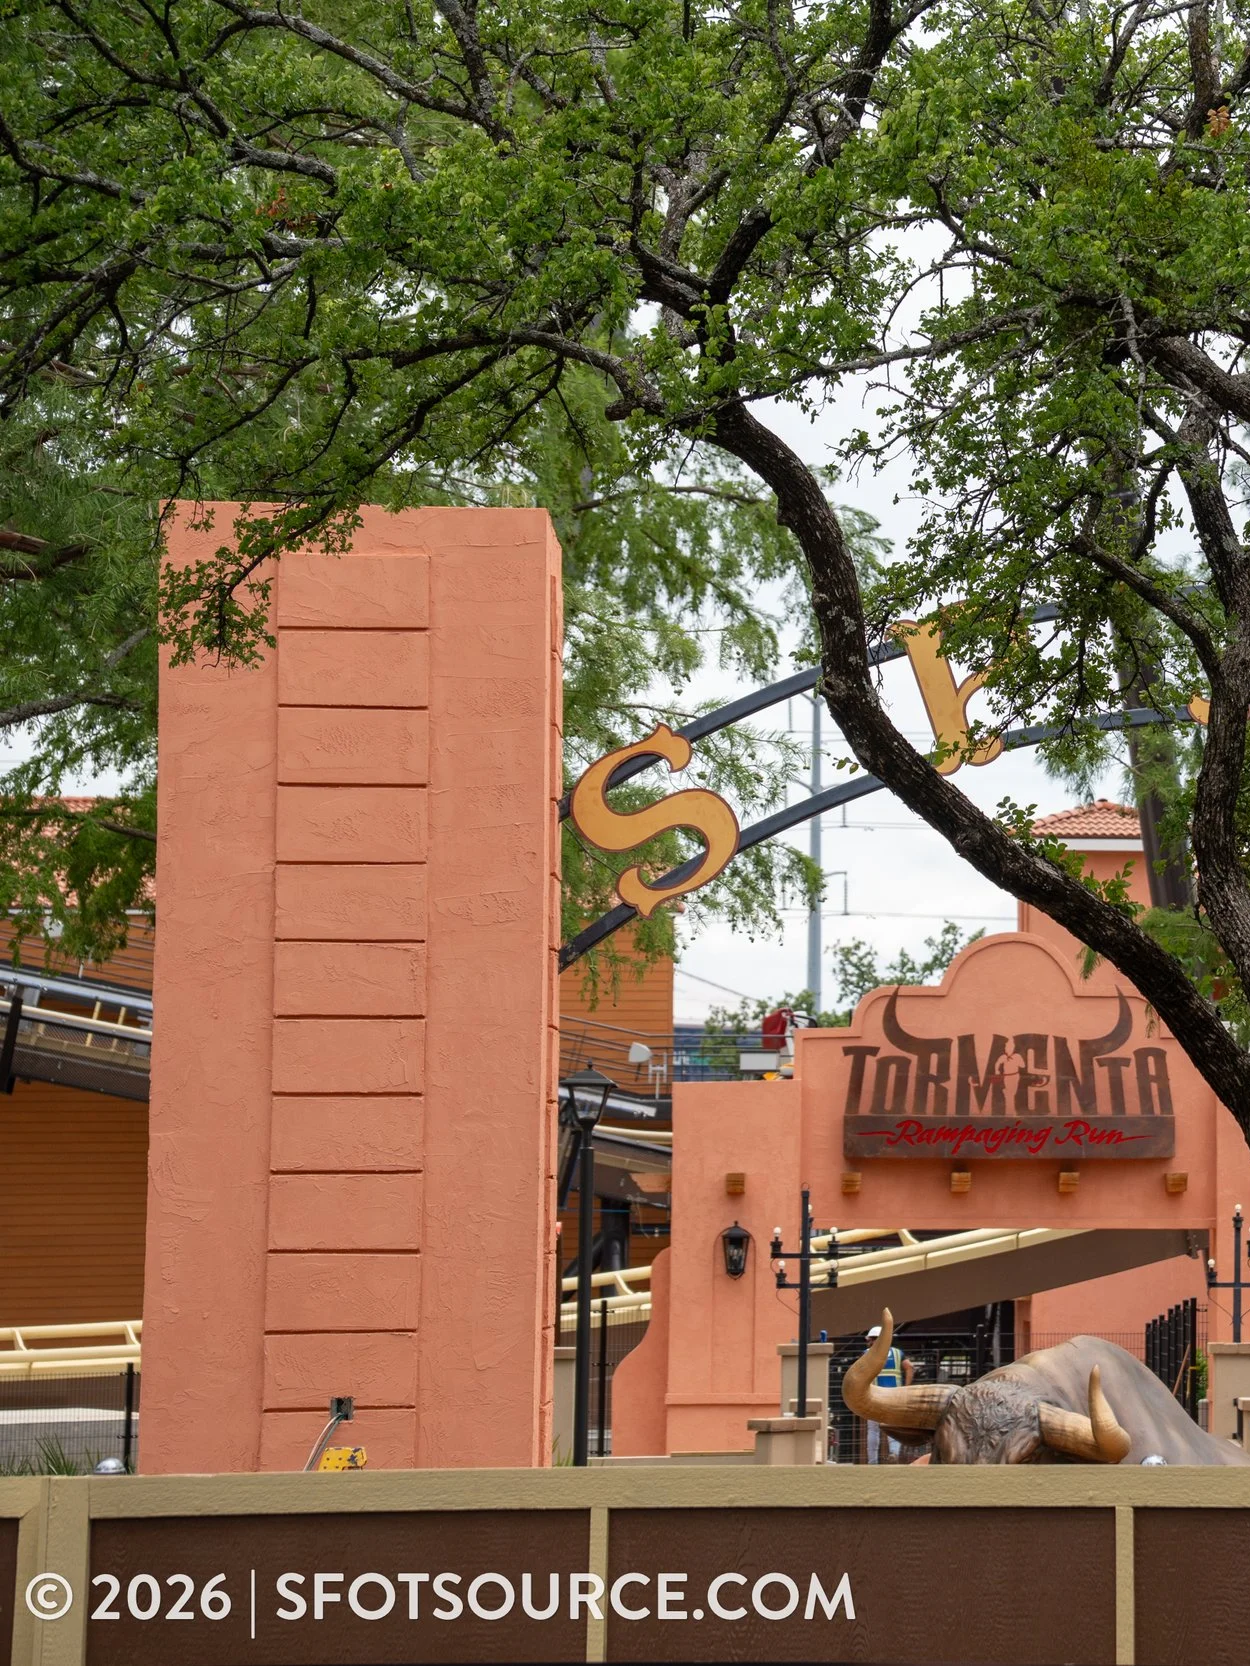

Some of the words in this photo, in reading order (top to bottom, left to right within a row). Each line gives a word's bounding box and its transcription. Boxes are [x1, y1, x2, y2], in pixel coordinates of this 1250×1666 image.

[842, 1031, 1174, 1116] TORMENTA
[884, 1118, 1052, 1155] Rampaging
[1054, 1118, 1133, 1146] Run
